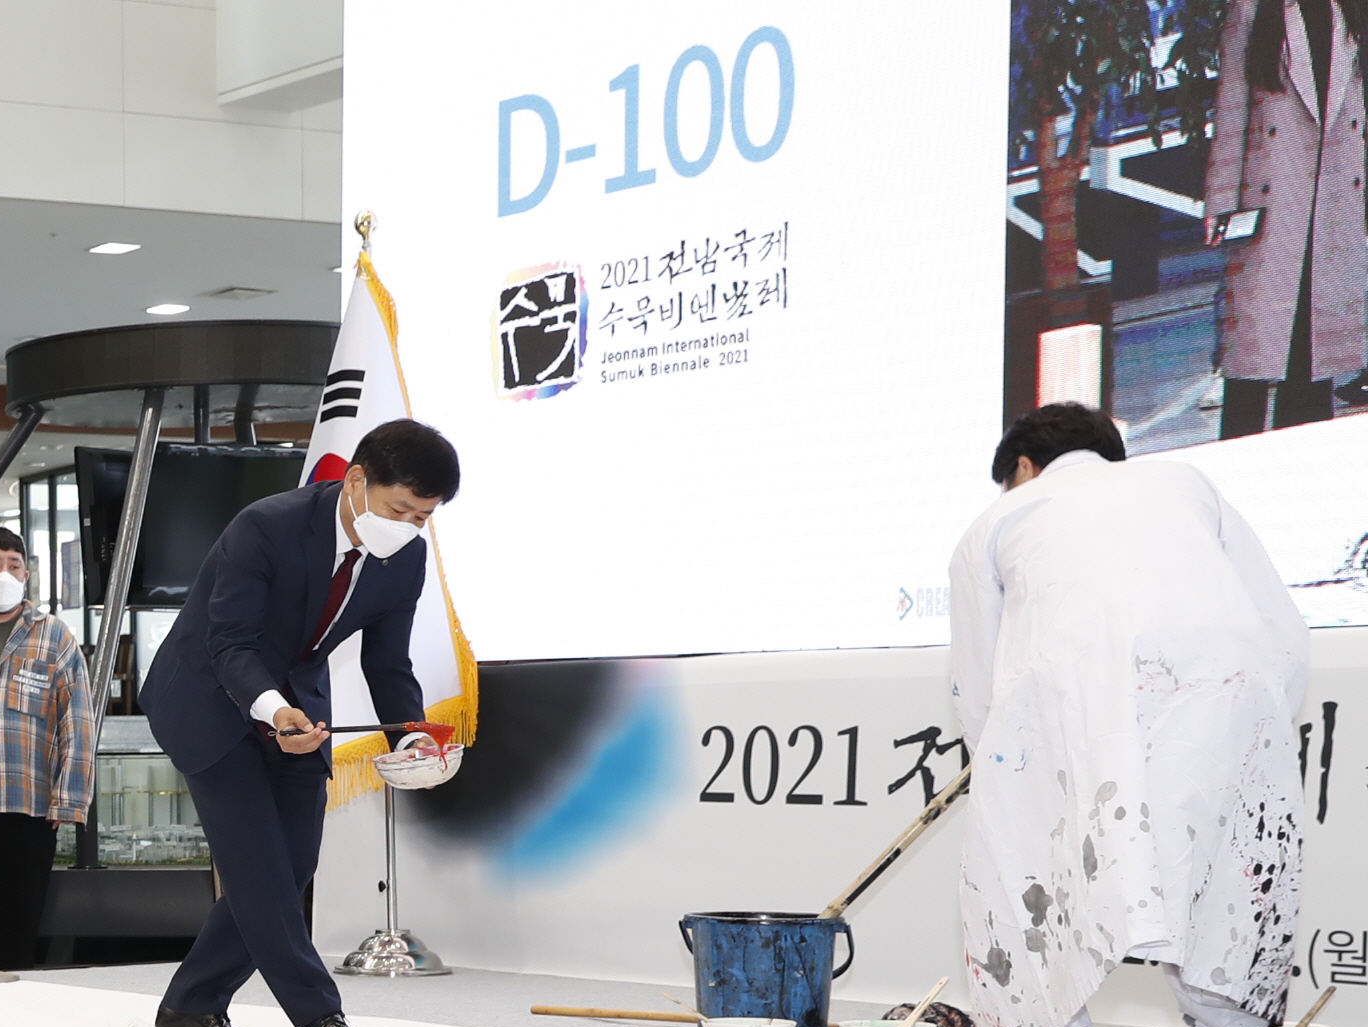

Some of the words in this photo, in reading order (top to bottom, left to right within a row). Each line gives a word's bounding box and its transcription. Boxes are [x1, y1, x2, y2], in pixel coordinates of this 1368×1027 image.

[498, 26, 795, 218] D-100
[600, 255, 652, 290] 2021
[658, 220, 789, 285] 전남국제
[598, 266, 788, 337] 수묵비엔날레
[600, 344, 659, 365] Jeonnam
[662, 328, 750, 356] International
[600, 364, 646, 384] Sumuk
[650, 356, 711, 377] Biennale
[718, 348, 749, 367] 2021
[698, 724, 869, 807] 2021
